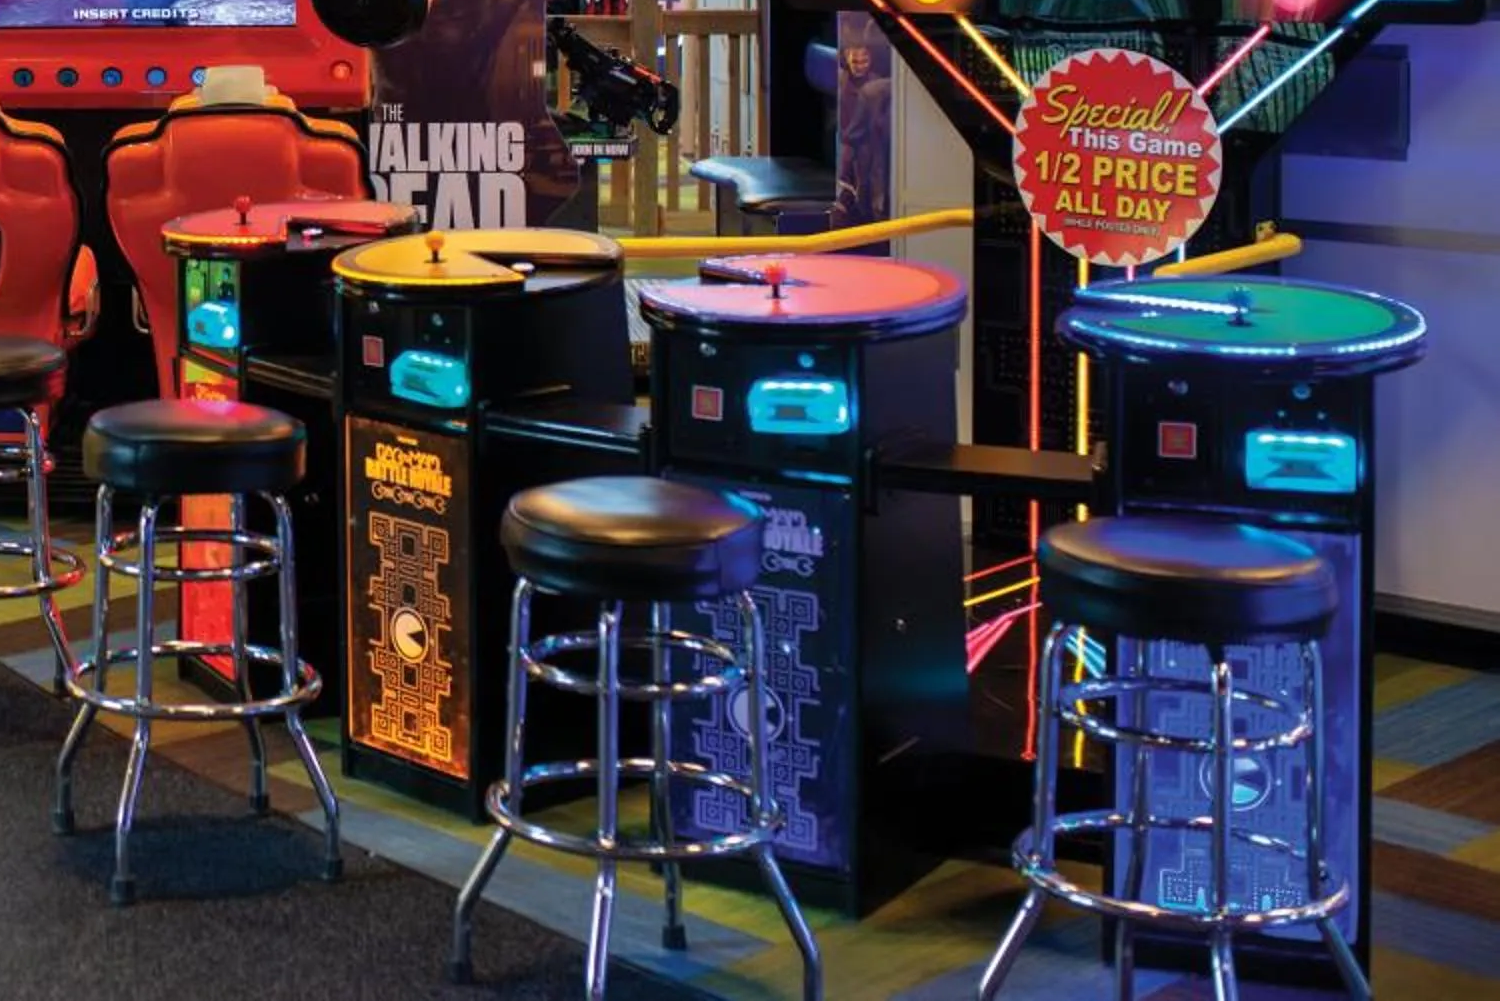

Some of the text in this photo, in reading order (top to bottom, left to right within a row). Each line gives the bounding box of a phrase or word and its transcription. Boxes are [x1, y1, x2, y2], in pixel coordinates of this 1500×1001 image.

[73, 8, 199, 19] INSERT CREDITS
[382, 104, 404, 122] THE
[1041, 84, 1191, 139] Special!
[369, 122, 525, 172] ALKING
[1069, 127, 1202, 157] This Game
[1035, 150, 1197, 196] 1/2 PRICE
[1055, 190, 1171, 222] ALL DAY
